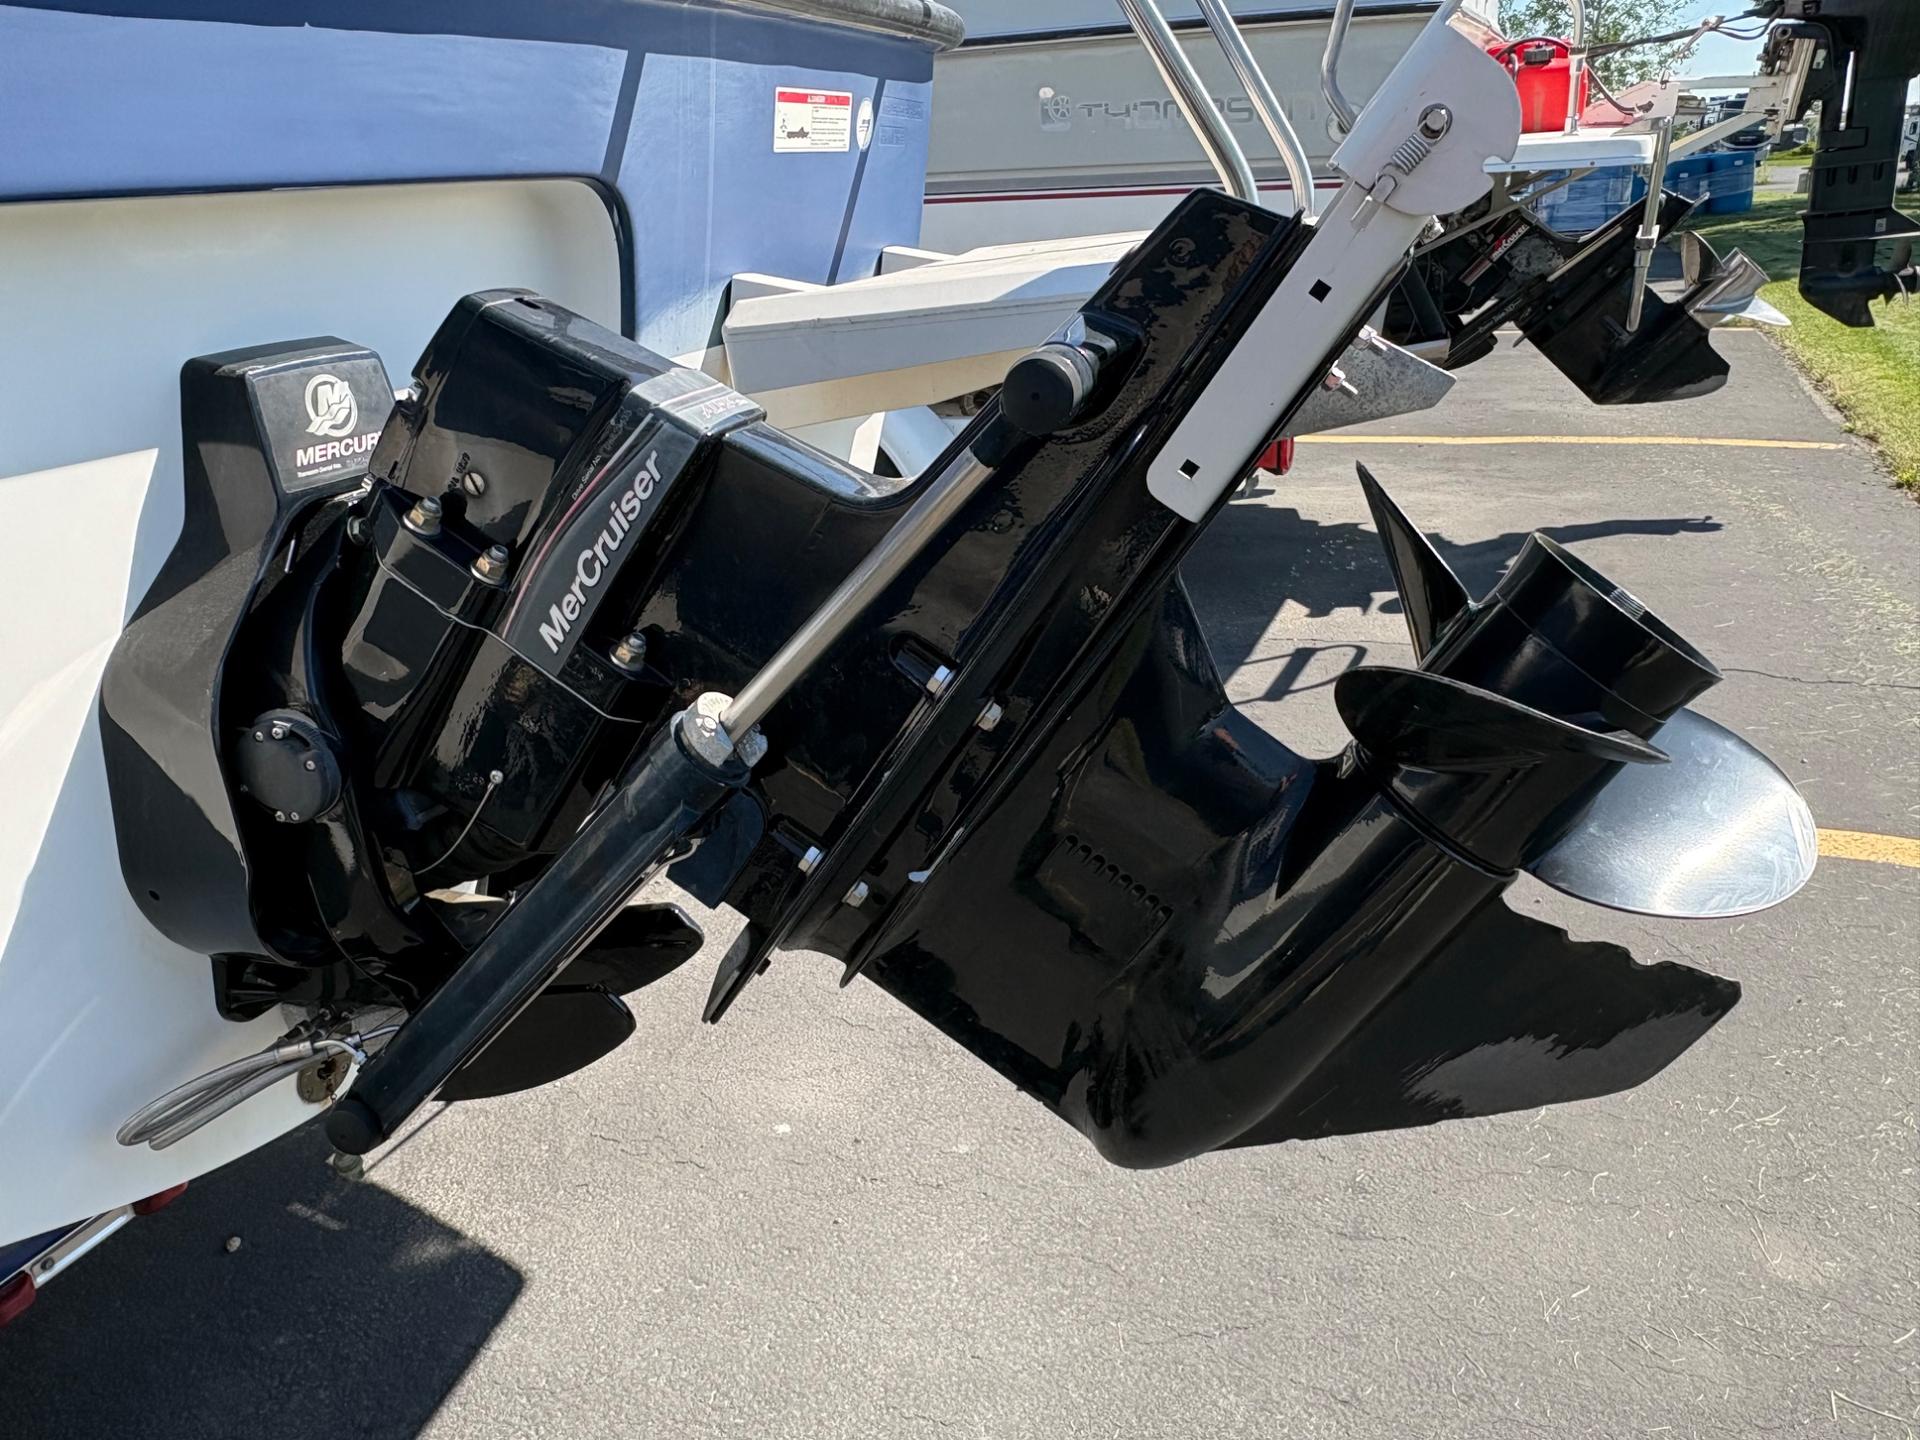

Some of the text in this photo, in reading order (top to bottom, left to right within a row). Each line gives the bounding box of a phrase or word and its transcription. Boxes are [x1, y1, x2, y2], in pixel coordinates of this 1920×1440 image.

[1075, 96, 1316, 123] THOMSN
[296, 431, 382, 467] MERCUR
[539, 450, 662, 654] MerCruiser
